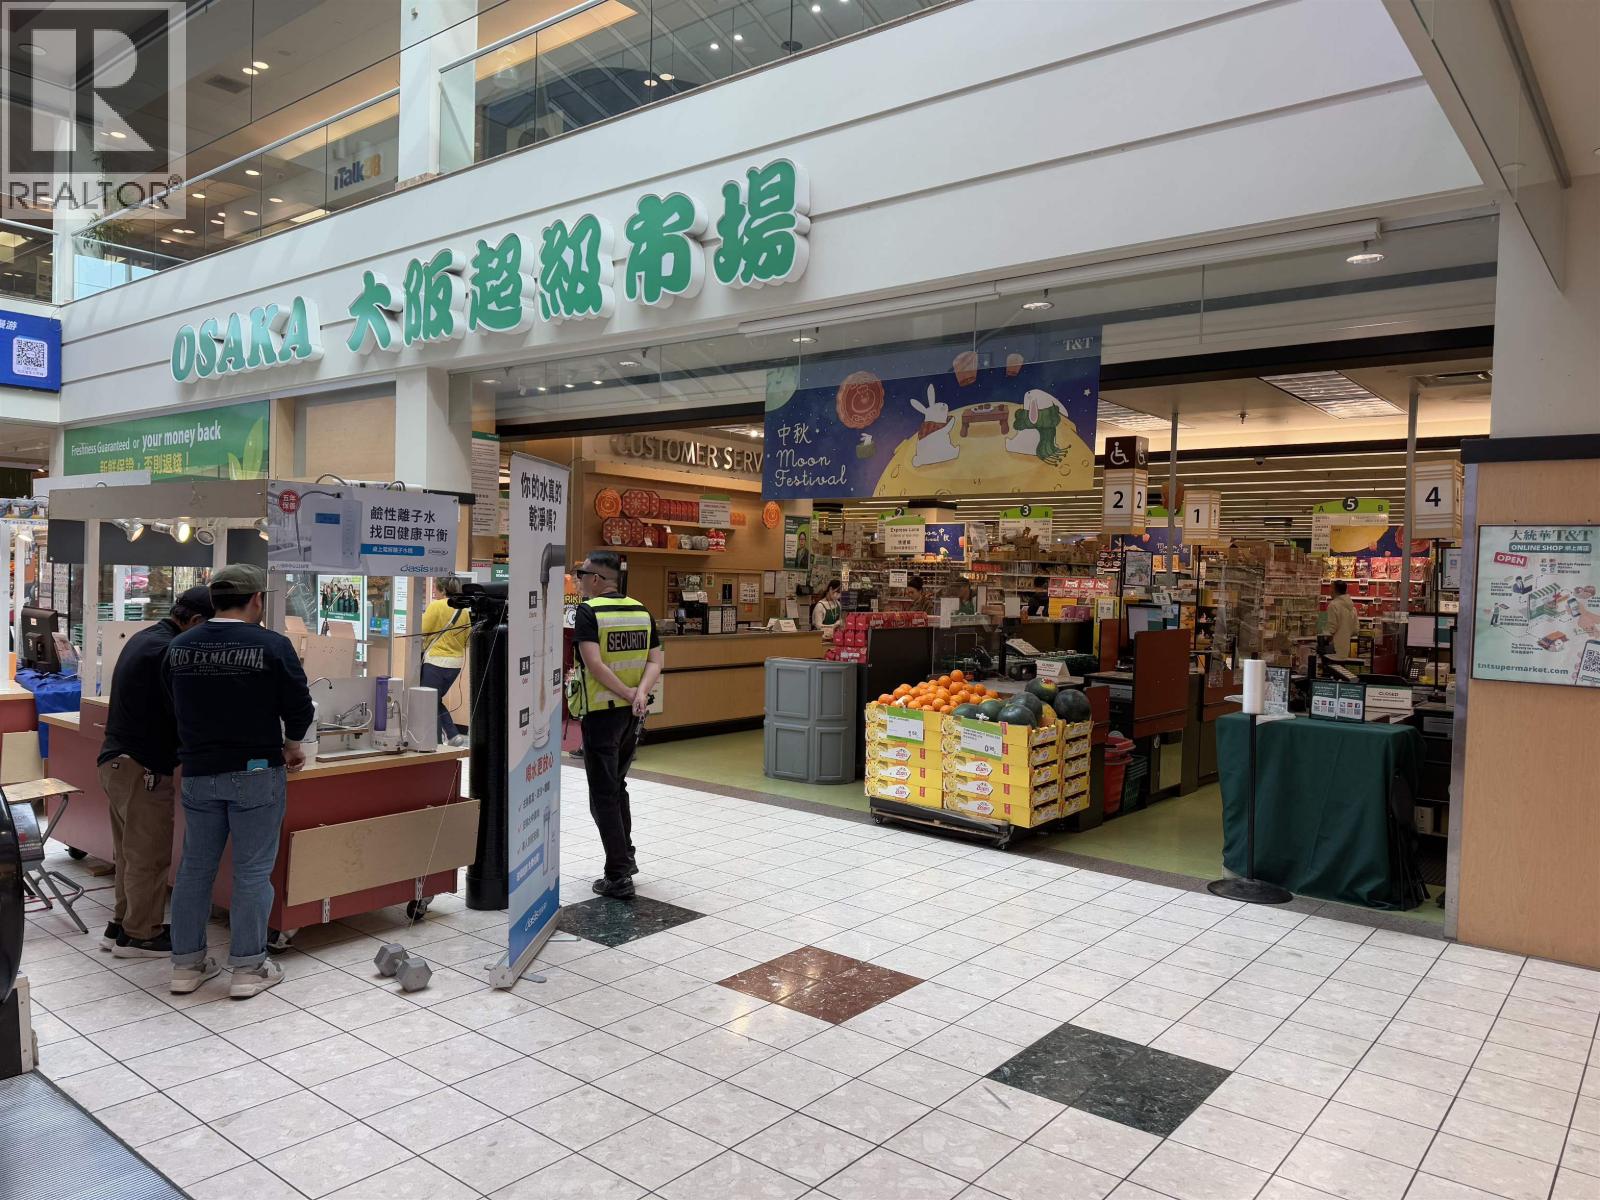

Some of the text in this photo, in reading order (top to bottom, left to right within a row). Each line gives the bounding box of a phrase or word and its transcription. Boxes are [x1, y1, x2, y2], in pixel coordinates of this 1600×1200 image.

[346, 157, 797, 354] 大阪超級市場
[170, 296, 313, 384] OSAKA
[1062, 336, 1094, 351] T&T
[71, 419, 222, 457] Freshness Guaranteed or your money back
[777, 423, 812, 446] 中秋
[616, 433, 719, 468] CUSTOMER
[776, 448, 831, 468] Moon
[774, 464, 848, 488] Festival
[520, 471, 562, 505] 你的水真的
[1425, 486, 1441, 507] 4
[1112, 490, 1124, 509] 2
[1136, 491, 1142, 509] 2
[1346, 498, 1356, 510] 5
[1378, 504, 1384, 512] B
[370, 506, 436, 524] 鹼性離子水
[1022, 505, 1029, 516] 3
[1193, 508, 1200, 524] 1
[369, 525, 449, 543] 找回健康平衡
[1511, 529, 1594, 542] 大統華 T&T
[1496, 554, 1525, 566] OPEN
[608, 630, 648, 651] SECURITY
[193, 650, 208, 664] EX
[209, 648, 264, 669] MACHINA
[1477, 662, 1569, 675] tntsupermarket.com
